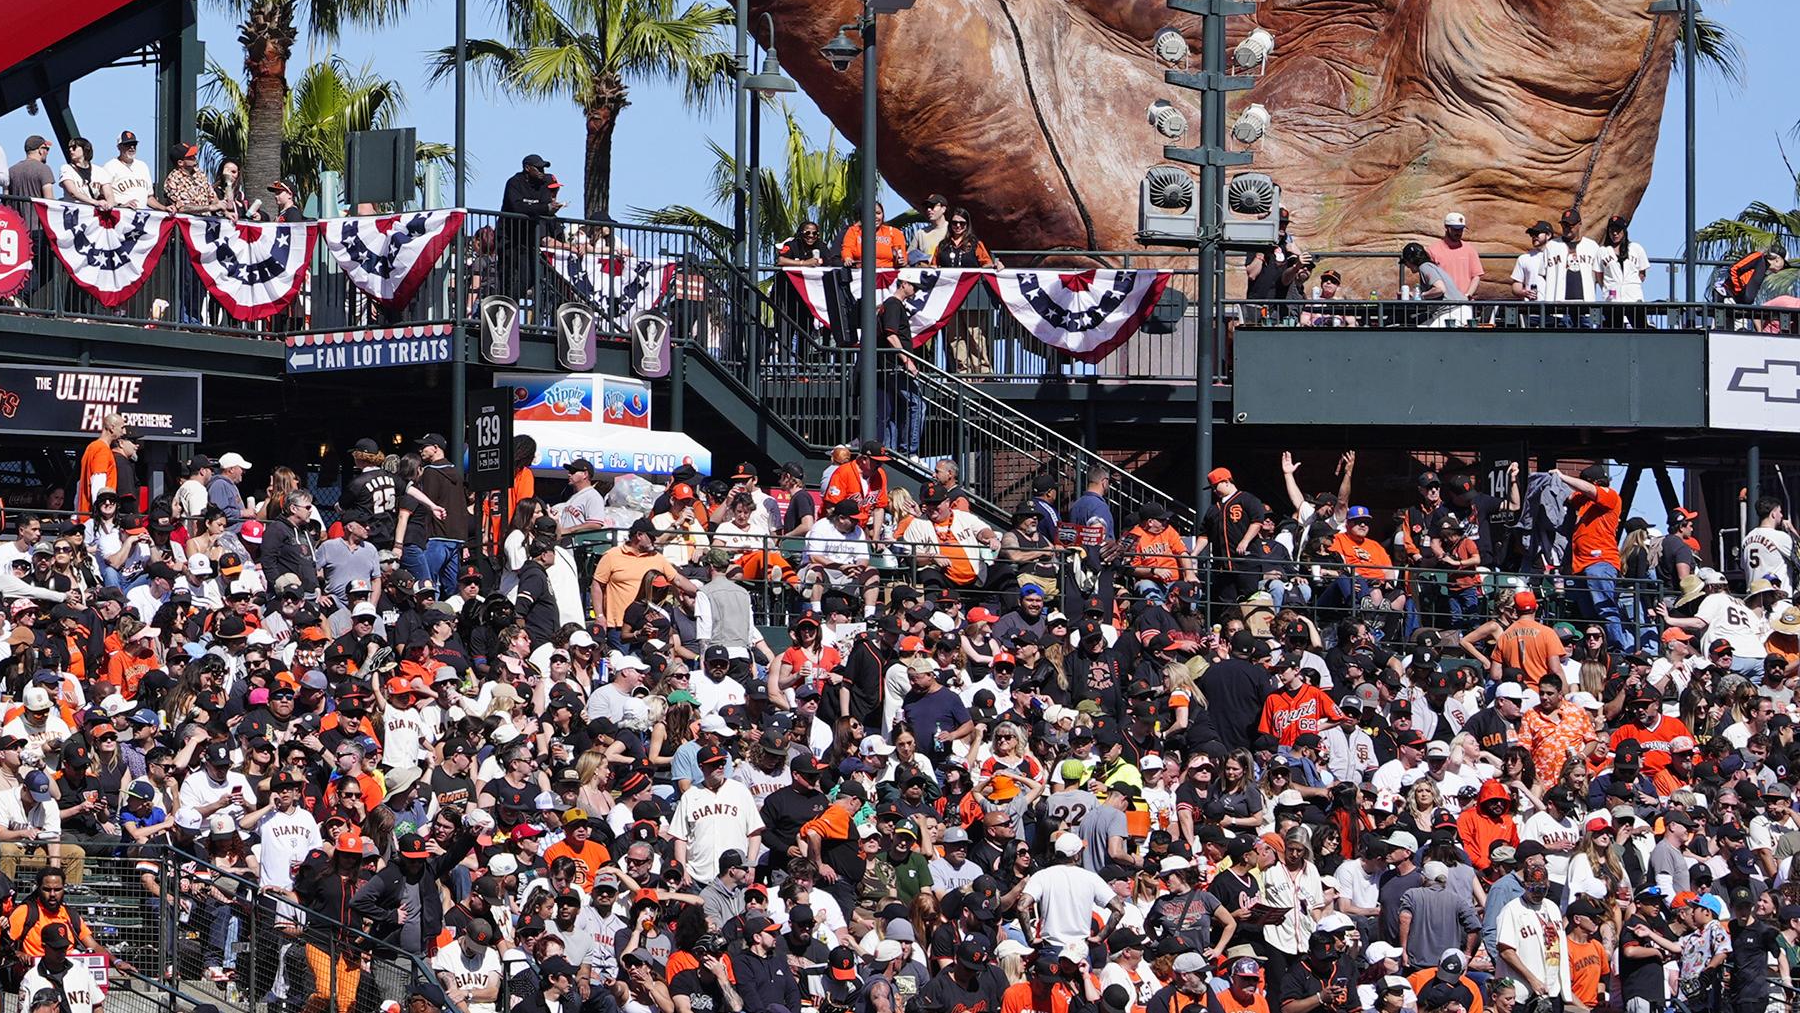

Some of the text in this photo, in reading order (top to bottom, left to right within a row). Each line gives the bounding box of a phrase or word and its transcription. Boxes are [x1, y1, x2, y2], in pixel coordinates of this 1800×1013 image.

[316, 339, 449, 370] FAN LOT TREATS
[36, 374, 143, 404] THE ULTIMATE
[121, 414, 173, 429] EXPERIENCE
[476, 415, 500, 447] 139
[548, 449, 676, 472] TASTE the FUN!
[366, 476, 396, 492] BONDS
[373, 488, 396, 514] 25
[1230, 503, 1243, 523] SF
[1750, 549, 1760, 568] 5
[1299, 719, 1316, 732] 62
[692, 802, 739, 821] GIANTS
[1054, 803, 1087, 828] 22
[272, 825, 311, 839] GIANTS
[454, 972, 489, 988] GIANT
